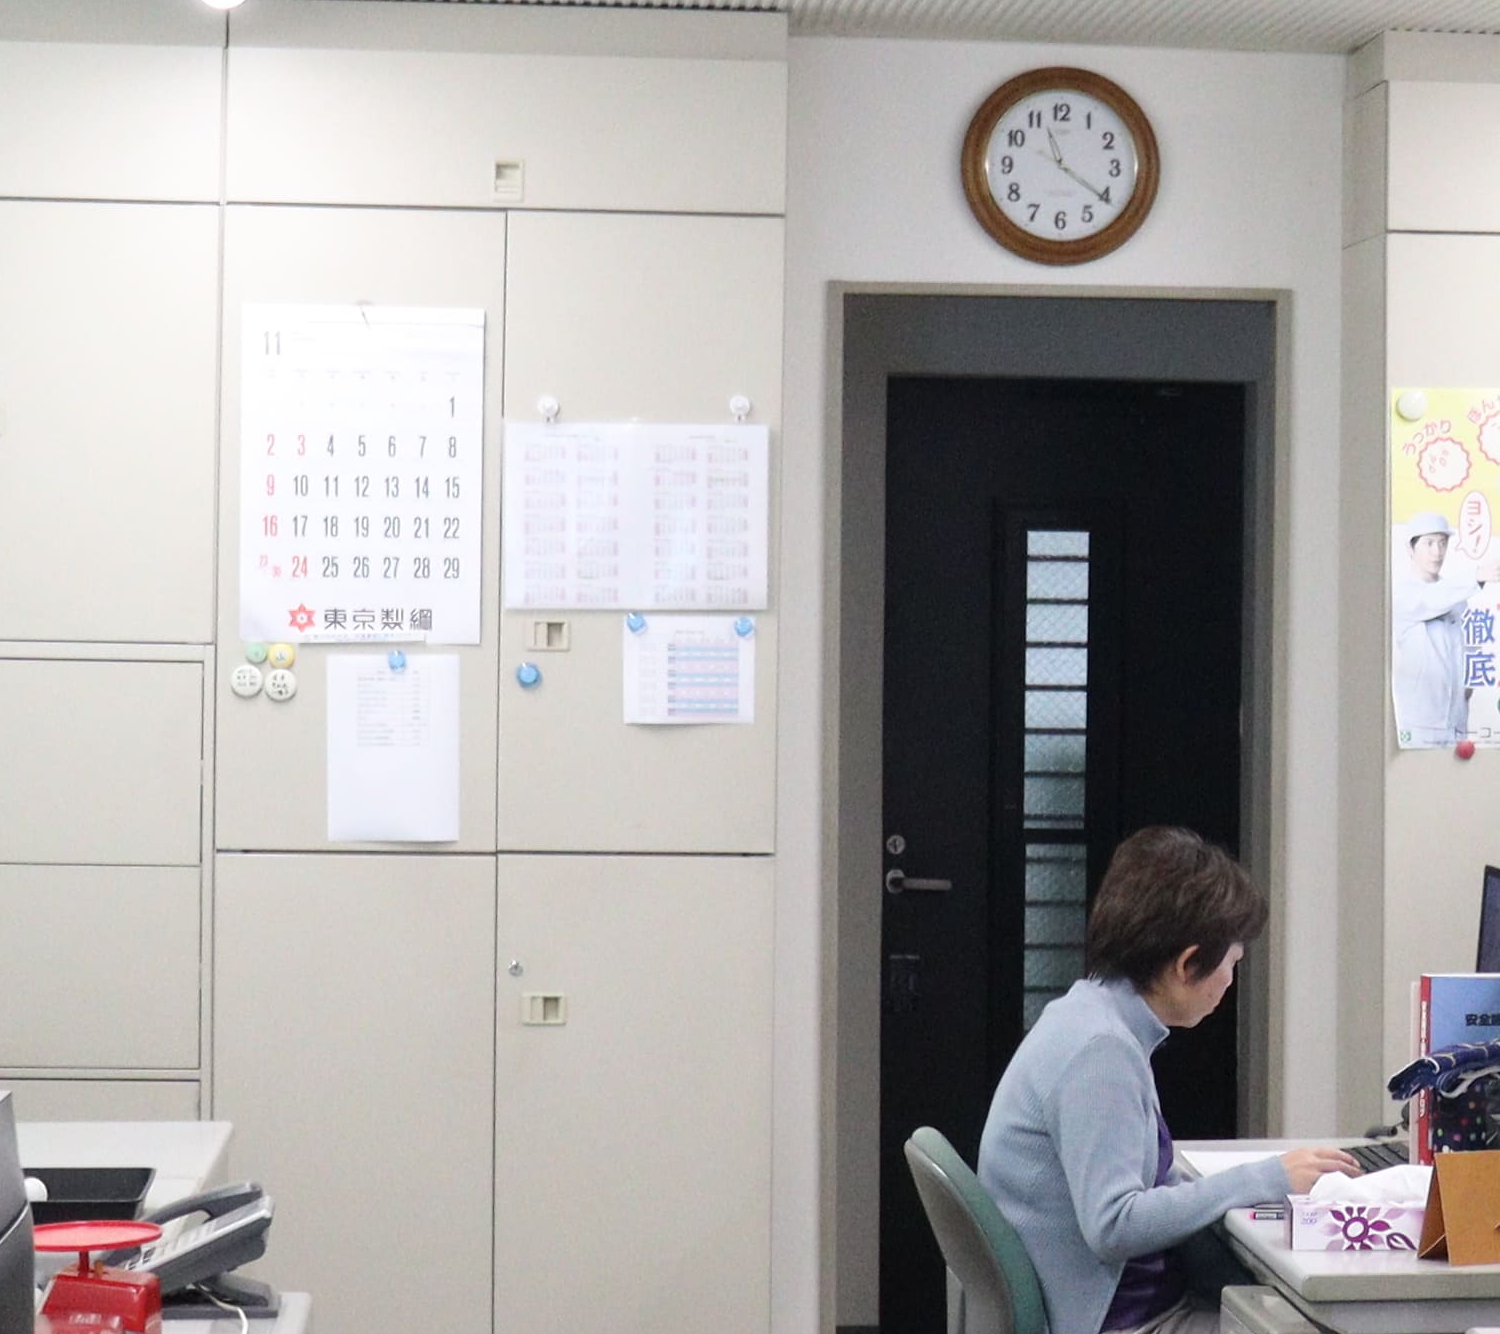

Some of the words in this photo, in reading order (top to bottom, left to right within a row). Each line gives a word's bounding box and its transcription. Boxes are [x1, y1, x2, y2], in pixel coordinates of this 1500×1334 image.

[1028, 110, 1042, 129] 11
[1053, 103, 1071, 122] 12
[1085, 111, 1092, 130] 1
[1007, 129, 1026, 148] 10
[1102, 131, 1115, 151] 2
[1001, 155, 1014, 174] 9
[1108, 158, 1122, 178] 3
[1007, 182, 1021, 202] 8
[1027, 203, 1041, 223] 7
[1054, 211, 1067, 230] 6
[1081, 204, 1094, 223] 5
[263, 331, 282, 356] 11
[449, 395, 456, 419] 1
[266, 432, 276, 457] 2
[296, 433, 306, 457] 3
[326, 434, 335, 457] 4
[357, 434, 367, 458] 5
[387, 435, 397, 458] 6
[419, 435, 428, 459] 7
[448, 435, 458, 459] 8
[265, 474, 276, 497] 9
[293, 474, 309, 497] 10
[323, 474, 339, 498] 11
[354, 475, 370, 498] 12
[384, 475, 400, 499] 13
[414, 475, 430, 499] 14
[444, 476, 461, 500] 15
[262, 514, 279, 537] 16
[292, 514, 309, 538] 17
[323, 515, 339, 538] 18
[353, 515, 370, 538] 19
[383, 515, 401, 539] 20
[413, 516, 430, 539] 21
[443, 516, 460, 540] 22
[291, 554, 309, 579] 24
[321, 555, 339, 579] 25
[352, 555, 370, 579] 26
[382, 556, 401, 580] 27
[413, 556, 431, 580] 28
[443, 556, 460, 580] 29
[1462, 607, 1496, 687] 徹底
